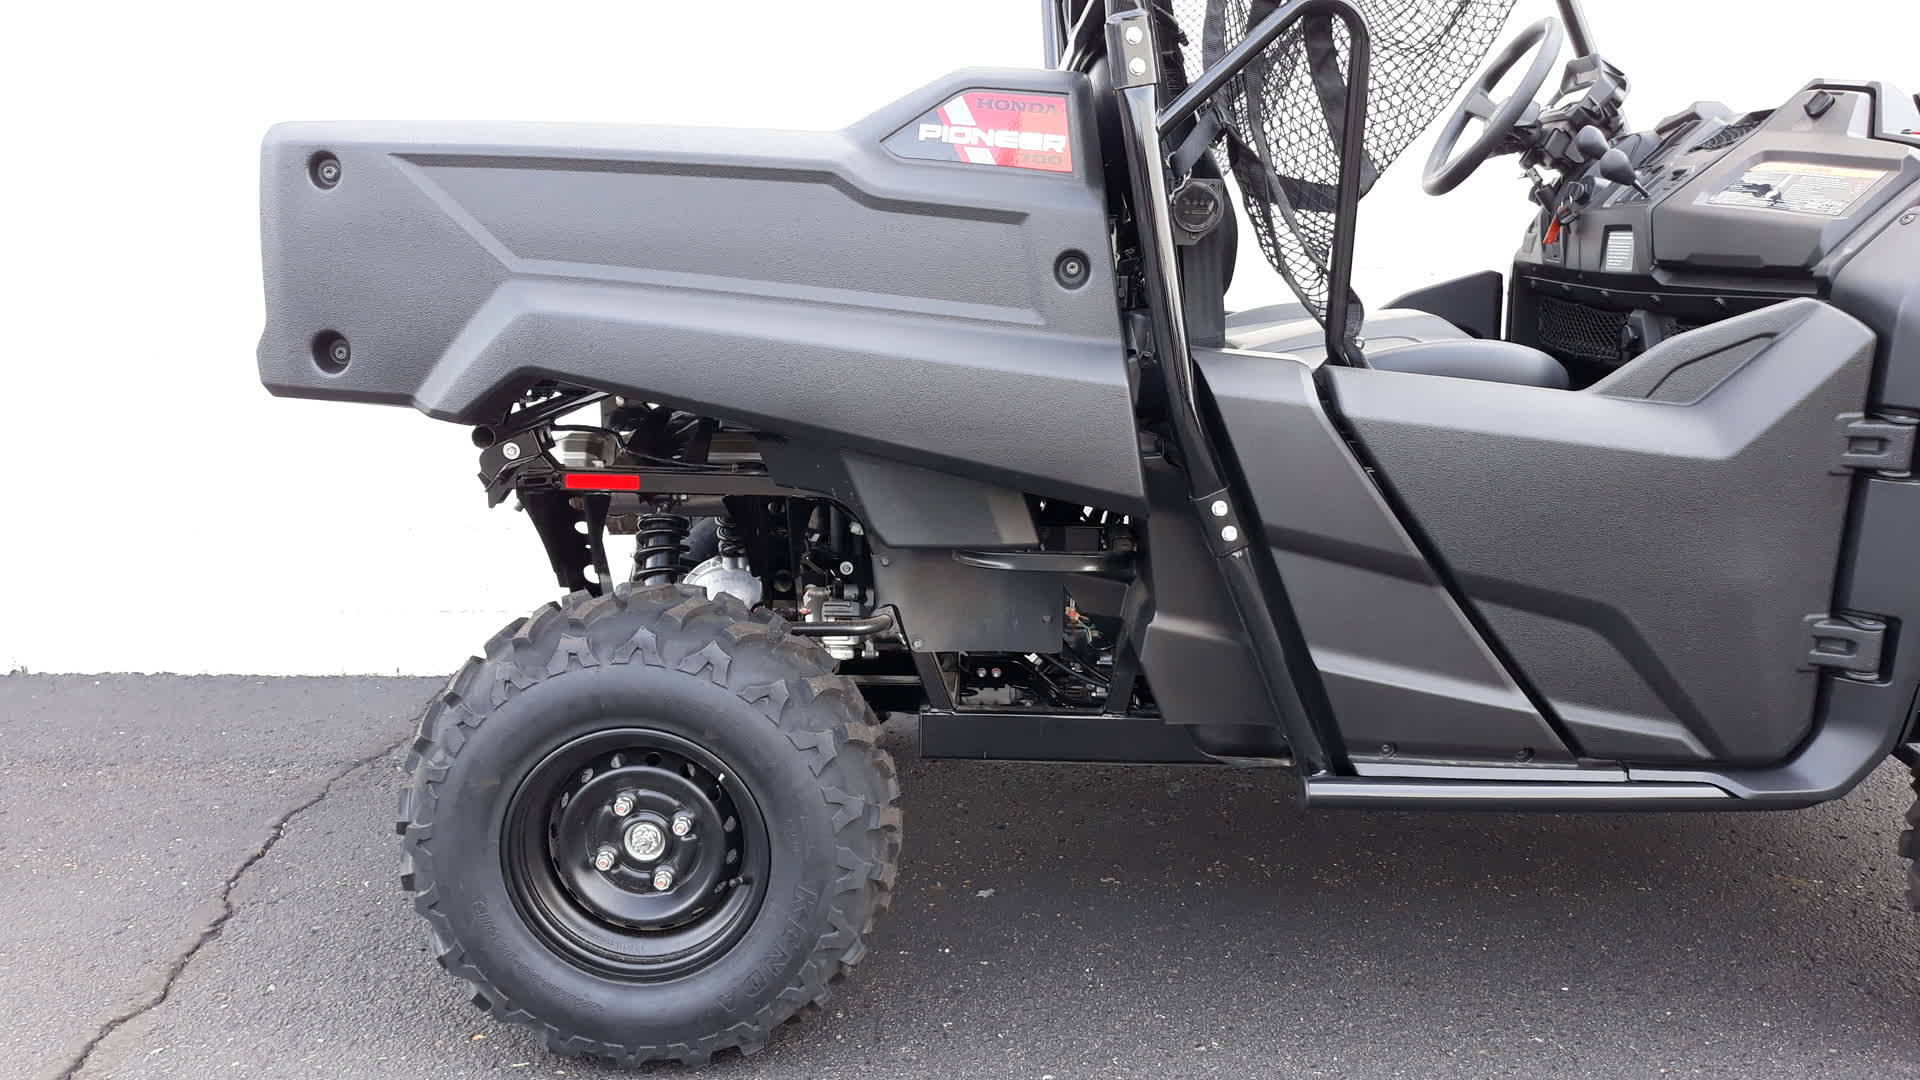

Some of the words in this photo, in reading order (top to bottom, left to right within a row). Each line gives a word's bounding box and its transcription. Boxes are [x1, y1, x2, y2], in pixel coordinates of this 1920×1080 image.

[976, 98, 1059, 114] HONDA
[918, 123, 1067, 153] PIONEER
[1018, 152, 1064, 166] 700
[713, 884, 818, 1014] KENDA
